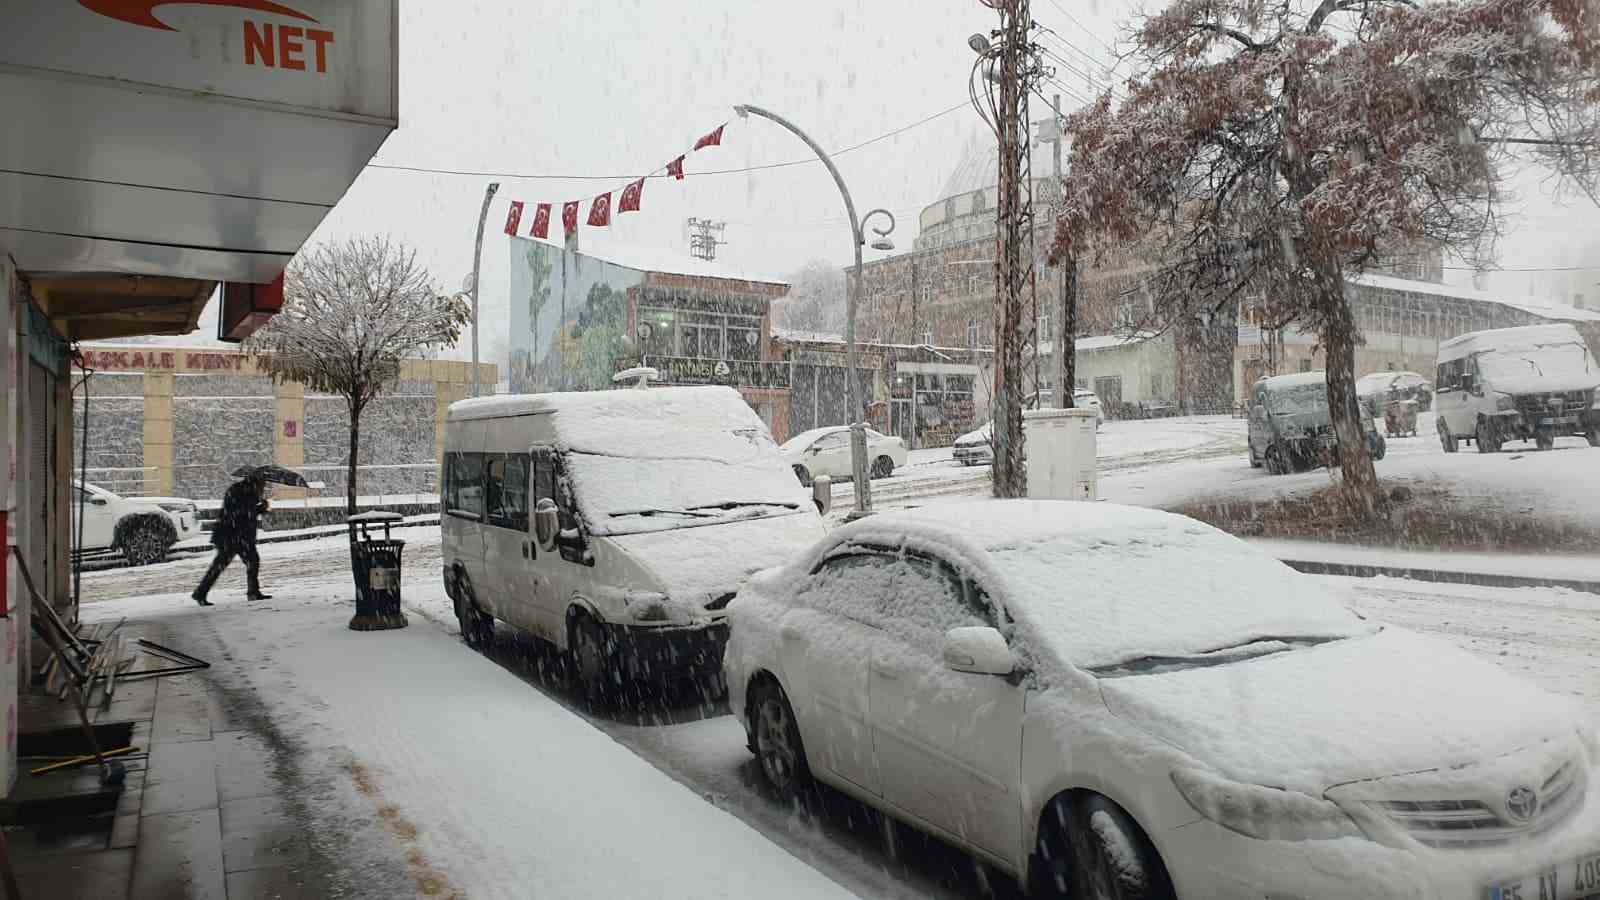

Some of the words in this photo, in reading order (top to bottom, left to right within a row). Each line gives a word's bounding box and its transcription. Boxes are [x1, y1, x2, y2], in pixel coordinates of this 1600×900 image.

[243, 20, 334, 73] NET
[74, 351, 175, 370] AŞKALE
[185, 353, 246, 370] KENT
